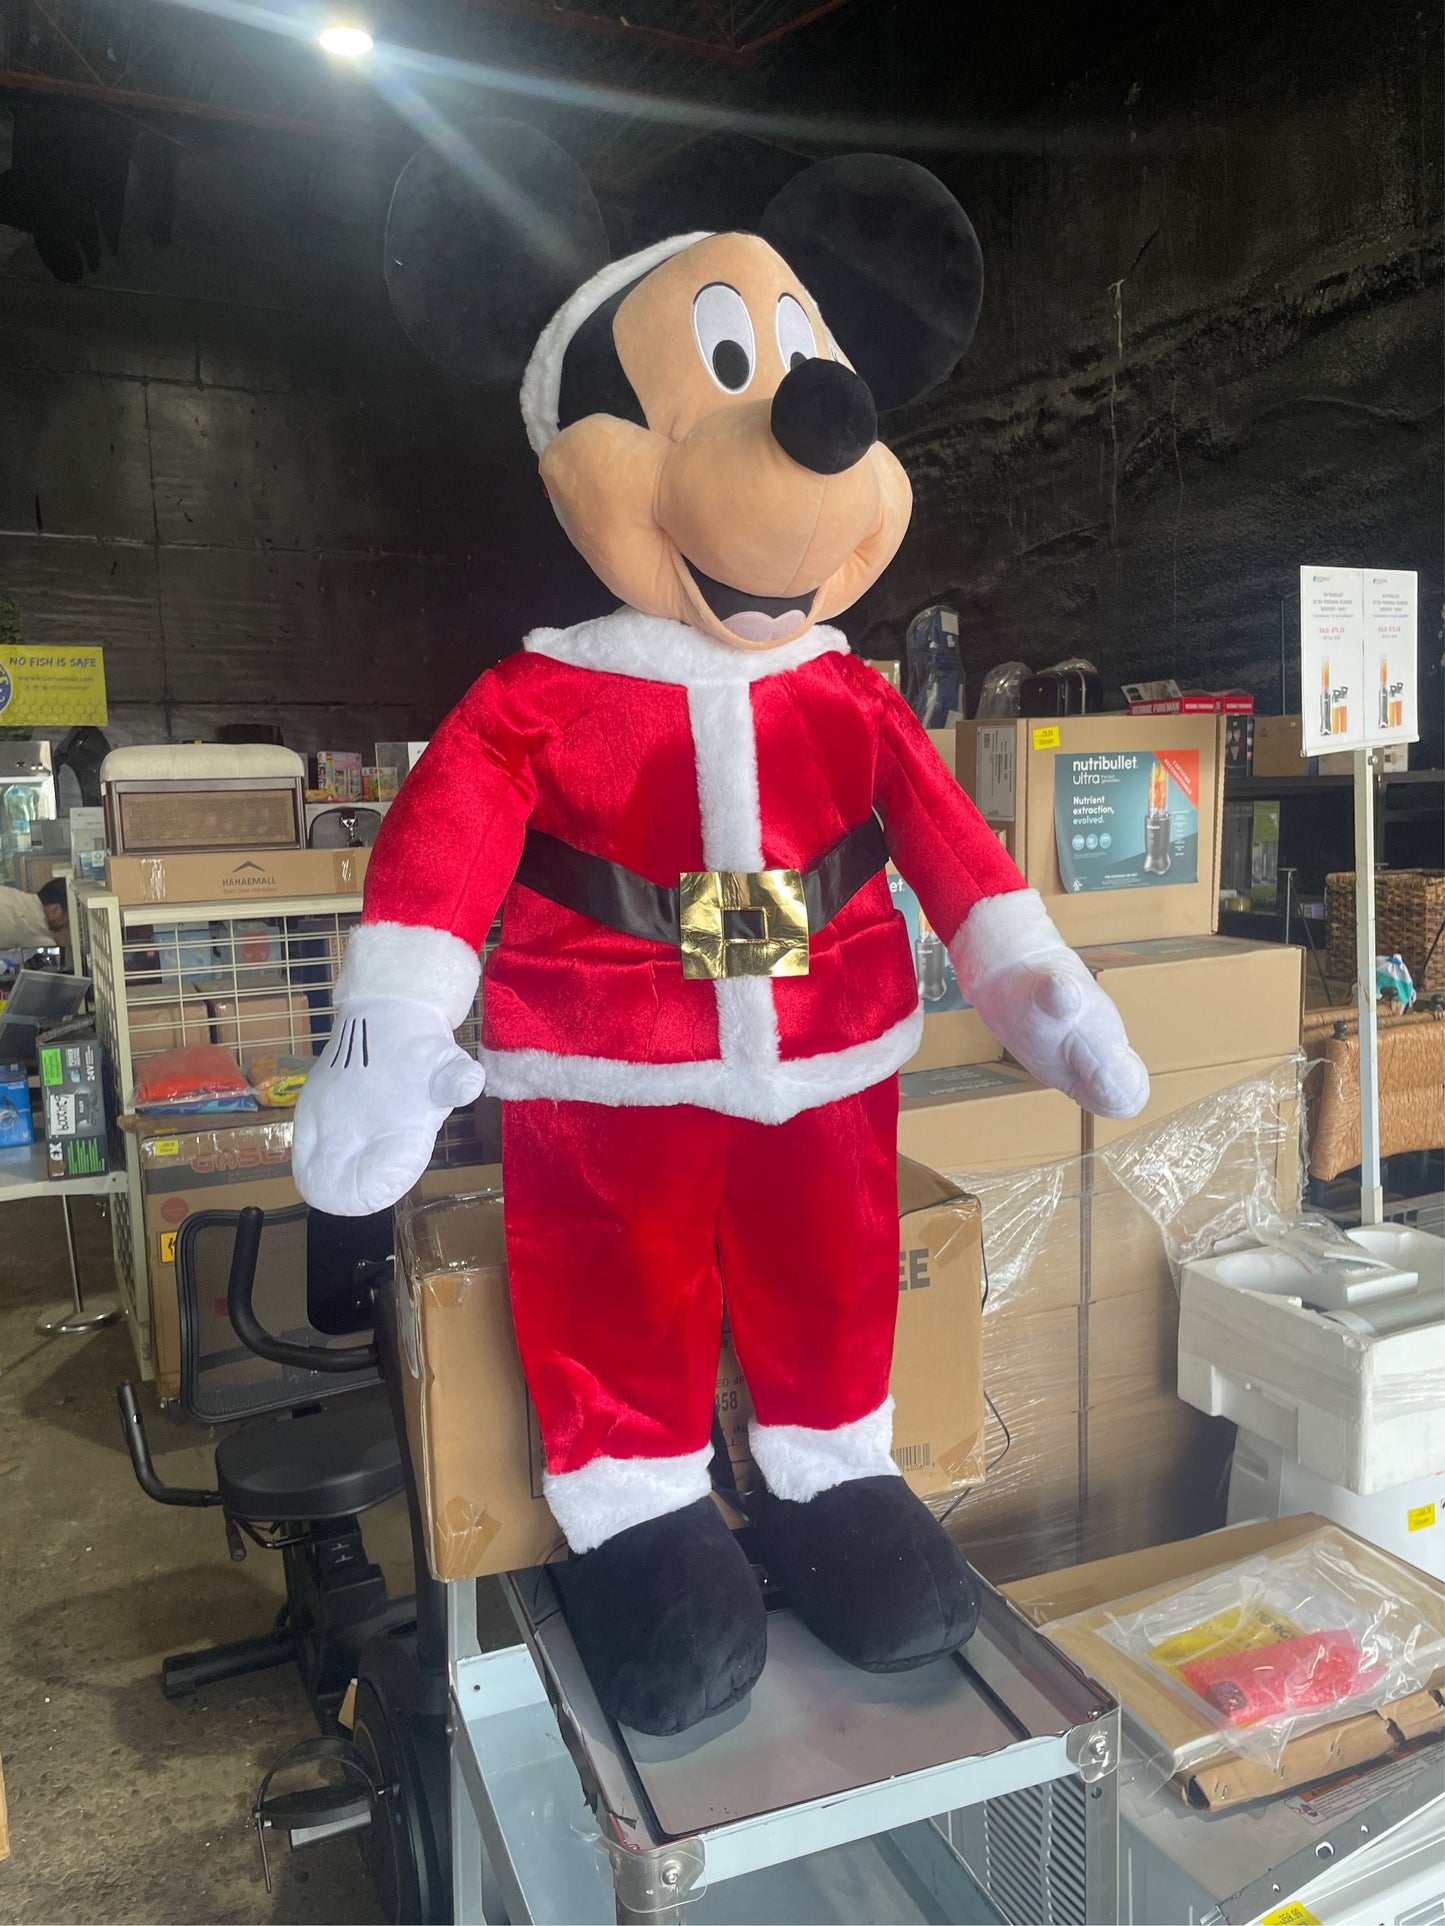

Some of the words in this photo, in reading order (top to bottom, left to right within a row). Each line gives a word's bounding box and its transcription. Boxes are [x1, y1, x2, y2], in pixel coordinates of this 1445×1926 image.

[9, 657, 26, 666] NO
[30, 657, 53, 667] FISH
[57, 657, 66, 667] IS
[70, 657, 96, 668] SAFE
[1132, 704, 1153, 715] GEORGE
[1153, 702, 1180, 713] FOREMAN
[1073, 755, 1137, 771] nutribullet
[1073, 772, 1100, 785] ultra
[1073, 796, 1105, 805] Nutrient
[1073, 805, 1114, 815] extraction,
[1073, 815, 1105, 825] evolved.
[222, 877, 276, 886] HAHAEMALL
[86, 1065, 95, 1081] 24V
